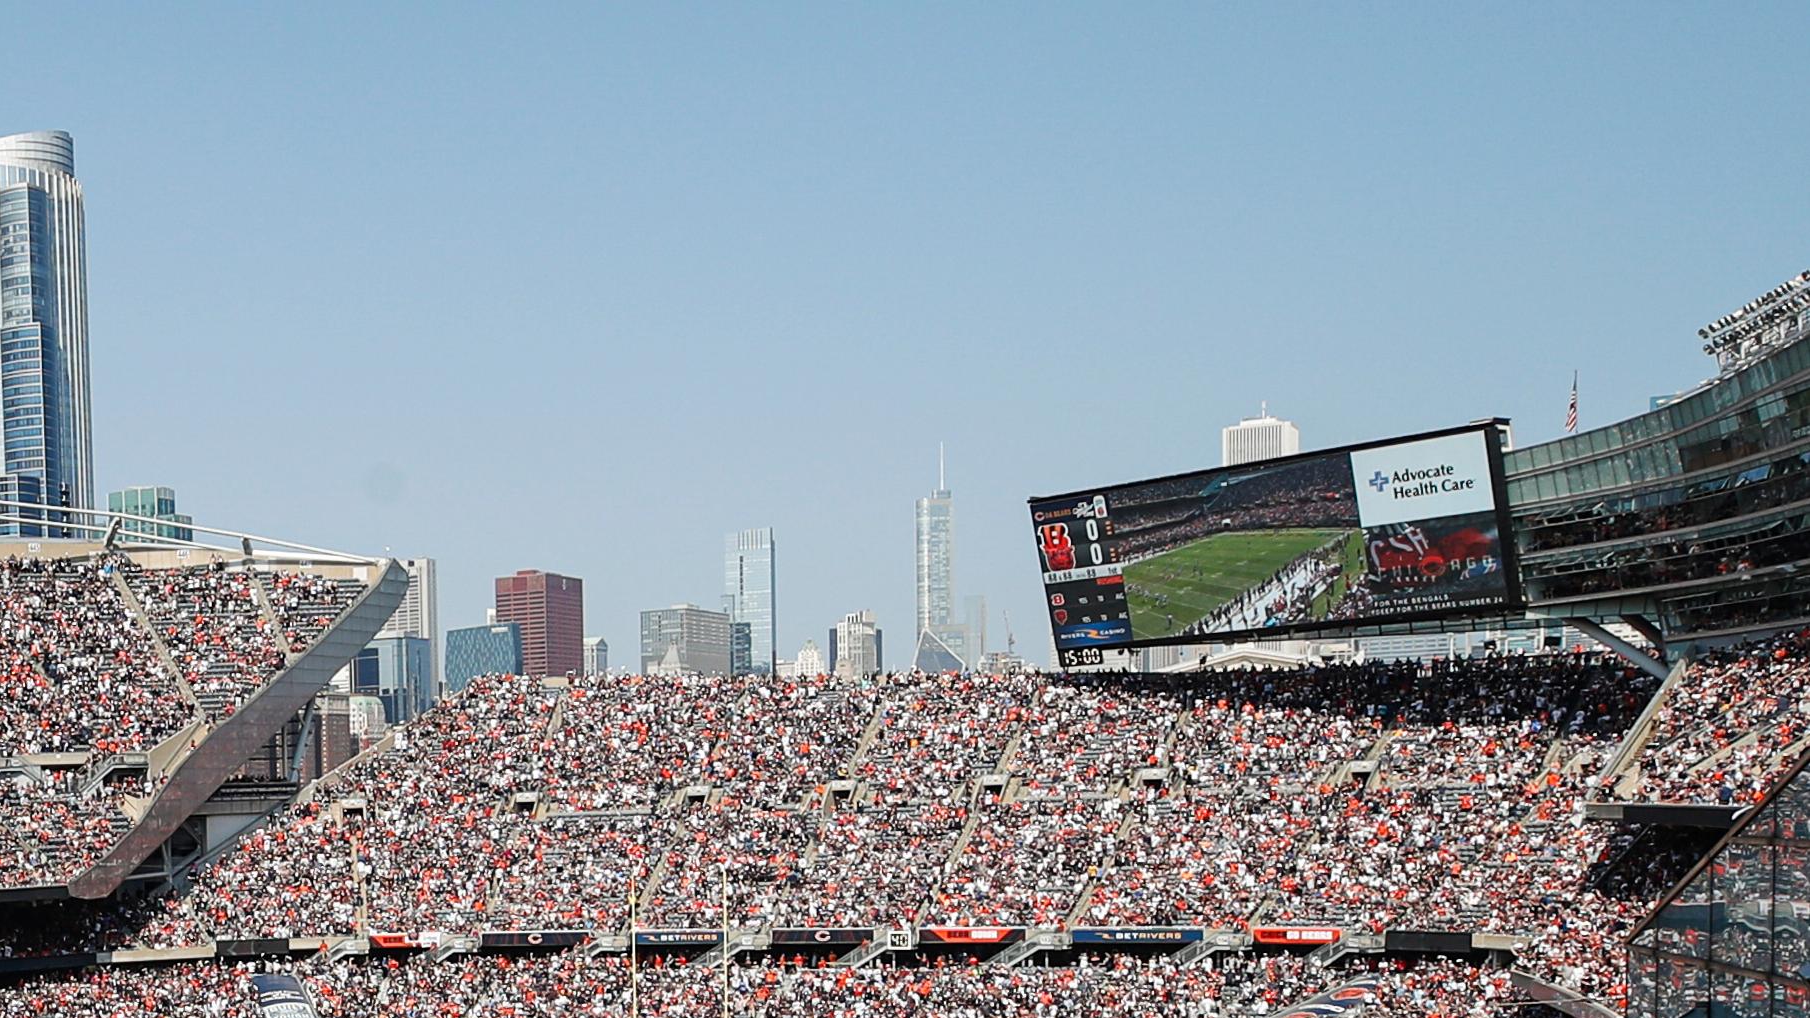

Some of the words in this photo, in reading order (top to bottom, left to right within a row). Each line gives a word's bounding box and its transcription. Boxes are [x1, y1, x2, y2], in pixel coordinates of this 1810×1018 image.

[1392, 464, 1454, 484] Advocate
[1393, 482, 1438, 499] Health
[1442, 479, 1474, 492] Care
[1085, 519, 1099, 541] 0
[1090, 543, 1103, 565] 0
[1374, 600, 1391, 608] FOR
[1393, 598, 1408, 607] THE
[1411, 594, 1449, 605] BENGALS
[1397, 605, 1412, 614] FOR
[1414, 603, 1429, 612] THE
[1432, 601, 1457, 610] BEARS
[1459, 598, 1491, 607] NUMBER
[1061, 632, 1086, 640] RIVERS
[1099, 627, 1126, 636] CASINO
[1063, 648, 1101, 666] 15:00
[660, 933, 718, 942] BETRIVERS
[891, 933, 909, 946] 40
[1115, 932, 1182, 940] BETRIVERS
